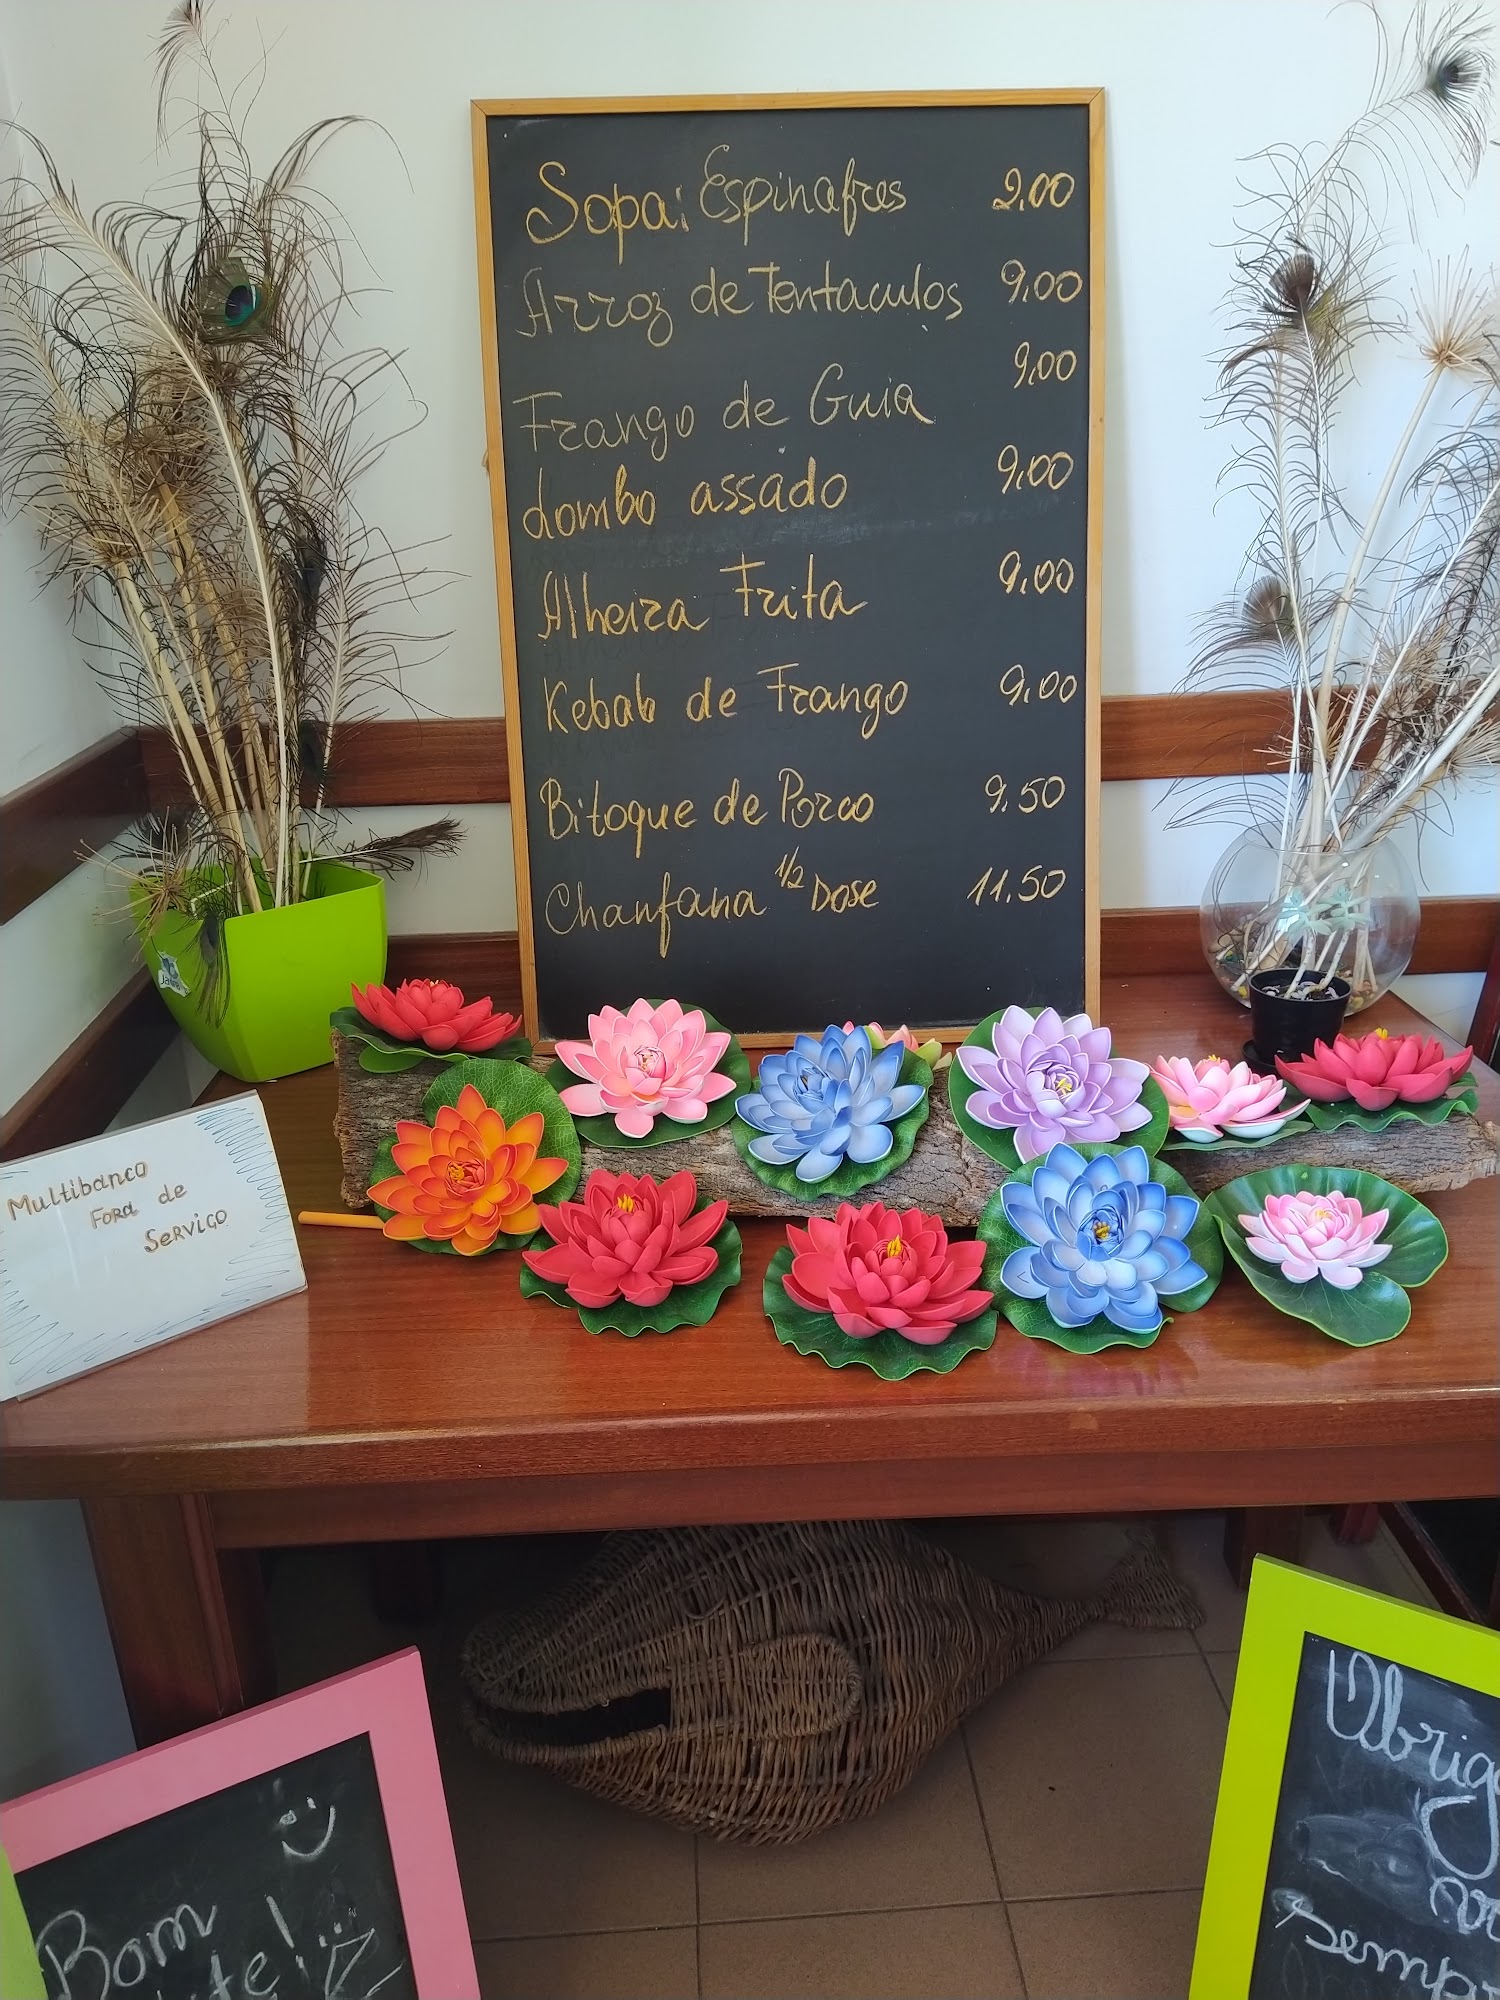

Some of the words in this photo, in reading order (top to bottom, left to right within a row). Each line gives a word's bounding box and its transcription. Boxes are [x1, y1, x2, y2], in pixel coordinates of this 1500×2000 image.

[515, 266, 674, 347] Arroz
[690, 266, 755, 318] de
[747, 260, 964, 322] Tentaculos
[512, 391, 695, 462] Frango
[722, 379, 790, 430] de
[808, 362, 937, 426] Guia
[690, 456, 849, 516] assado
[537, 570, 711, 640] Alheira
[718, 551, 869, 621] Frita
[543, 672, 656, 734] Kebab
[685, 675, 739, 722] de
[756, 661, 910, 740] Frango
[539, 777, 698, 859] Bitoque
[713, 777, 769, 826] de
[777, 767, 875, 829] Porco
[545, 870, 768, 959] Chanfana
[7, 1160, 149, 1221] Multibanco
[157, 1182, 188, 1205] de
[1326, 1649, 1500, 1881] Obrig
[36, 1903, 218, 2000] Bom
